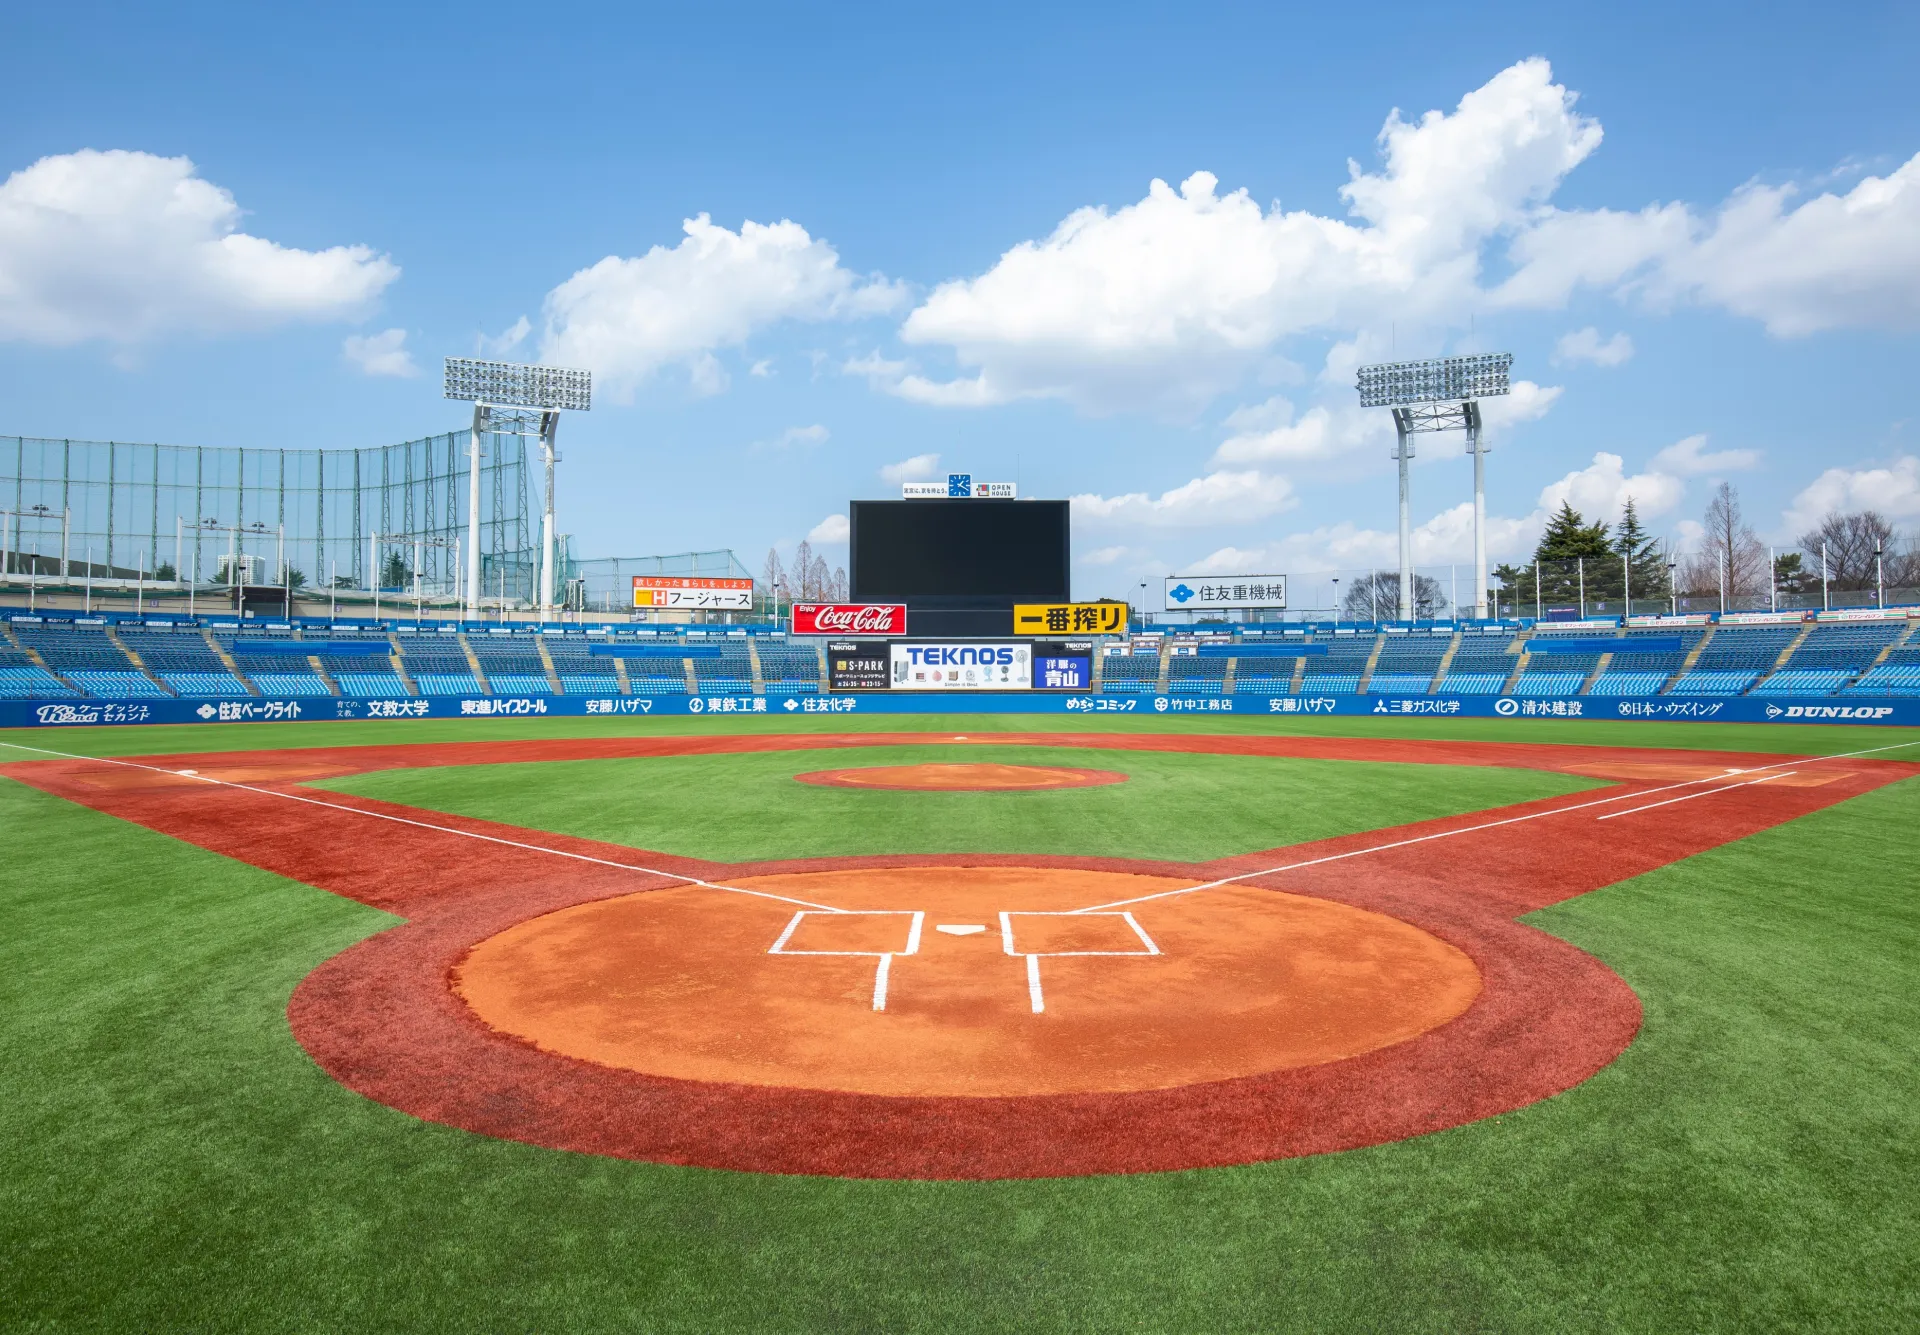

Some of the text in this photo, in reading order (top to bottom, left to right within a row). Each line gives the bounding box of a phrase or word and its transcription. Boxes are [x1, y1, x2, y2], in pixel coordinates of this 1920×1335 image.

[636, 579, 750, 589] 欲しかった暮らしを、しよう。
[670, 592, 750, 606] フージャース
[1198, 584, 1282, 601] 住友重機械
[814, 606, 896, 630] Coca-Cola
[1021, 607, 1120, 631] 一番搾り
[906, 648, 1013, 665] TEKNOS
[849, 661, 884, 670] S-PARK
[1045, 670, 1079, 686] 青山
[80, 704, 148, 713] ケーダッシュ
[219, 702, 302, 720] 住友ベークライト
[368, 700, 429, 717] 文教大学
[461, 699, 547, 714] 東進ハイスクール
[586, 698, 652, 713] 安藤ハザマ
[708, 698, 767, 712] 東鉄工業
[802, 698, 856, 711] 住友化学
[1066, 697, 1136, 712] めちゃコミック
[1171, 699, 1233, 710] 竹中工務店
[1269, 697, 1336, 712] 安藤ハザマ
[1390, 700, 1460, 713] 三菱ガス化学
[1522, 700, 1583, 716] 清水建設
[1632, 702, 1723, 716] 日本ハウズイング
[1784, 706, 1894, 718] DUNLOP
[103, 713, 150, 721] セカンド
